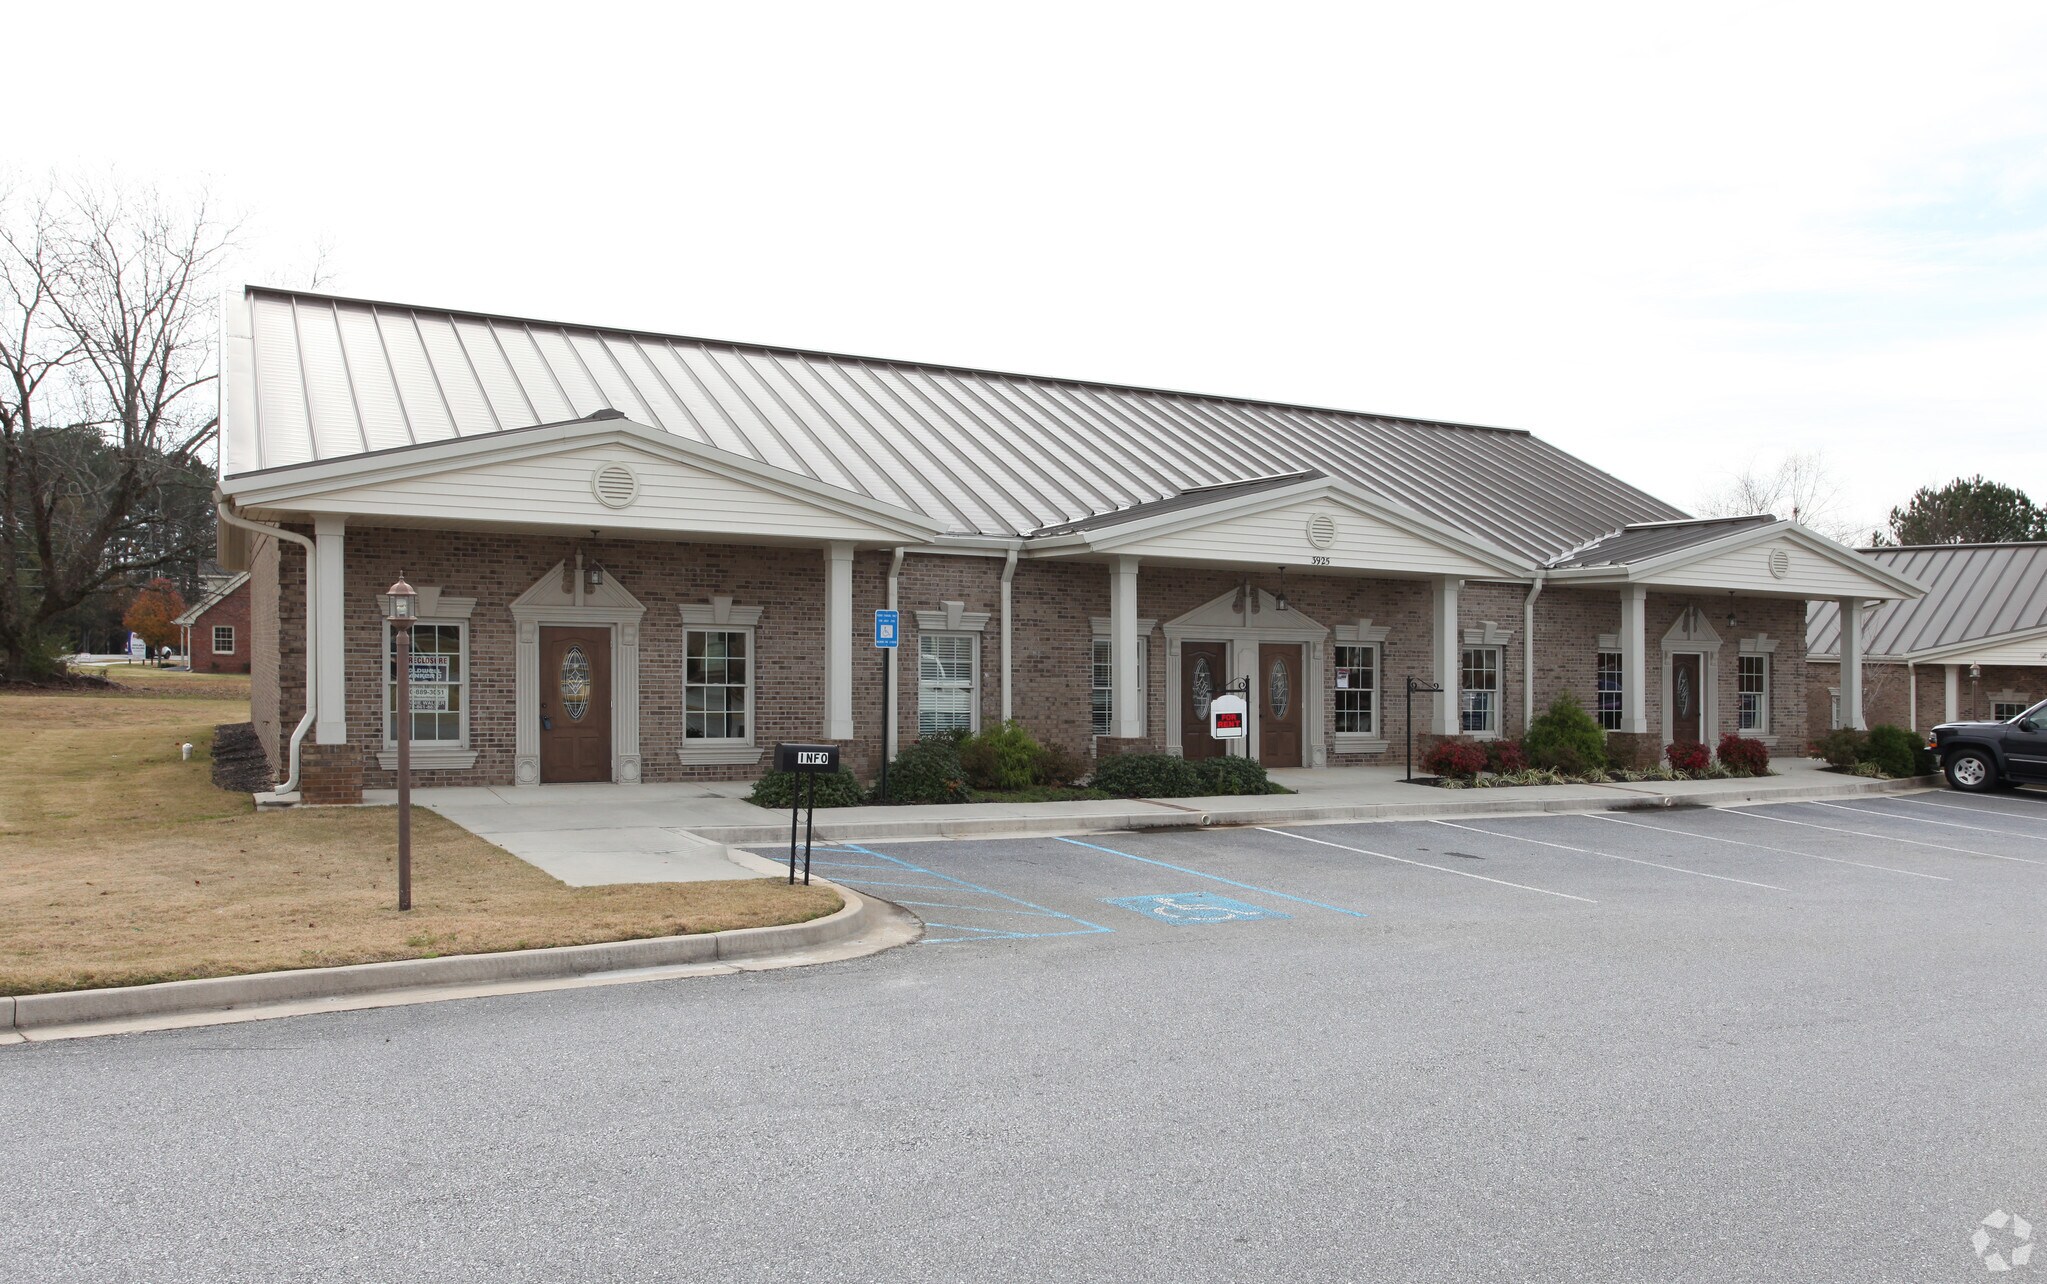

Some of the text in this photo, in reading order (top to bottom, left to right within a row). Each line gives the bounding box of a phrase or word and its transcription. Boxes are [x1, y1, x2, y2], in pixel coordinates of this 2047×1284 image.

[1312, 557, 1330, 565] 3925
[1217, 720, 1241, 728] RENT
[800, 753, 828, 764] INFO
